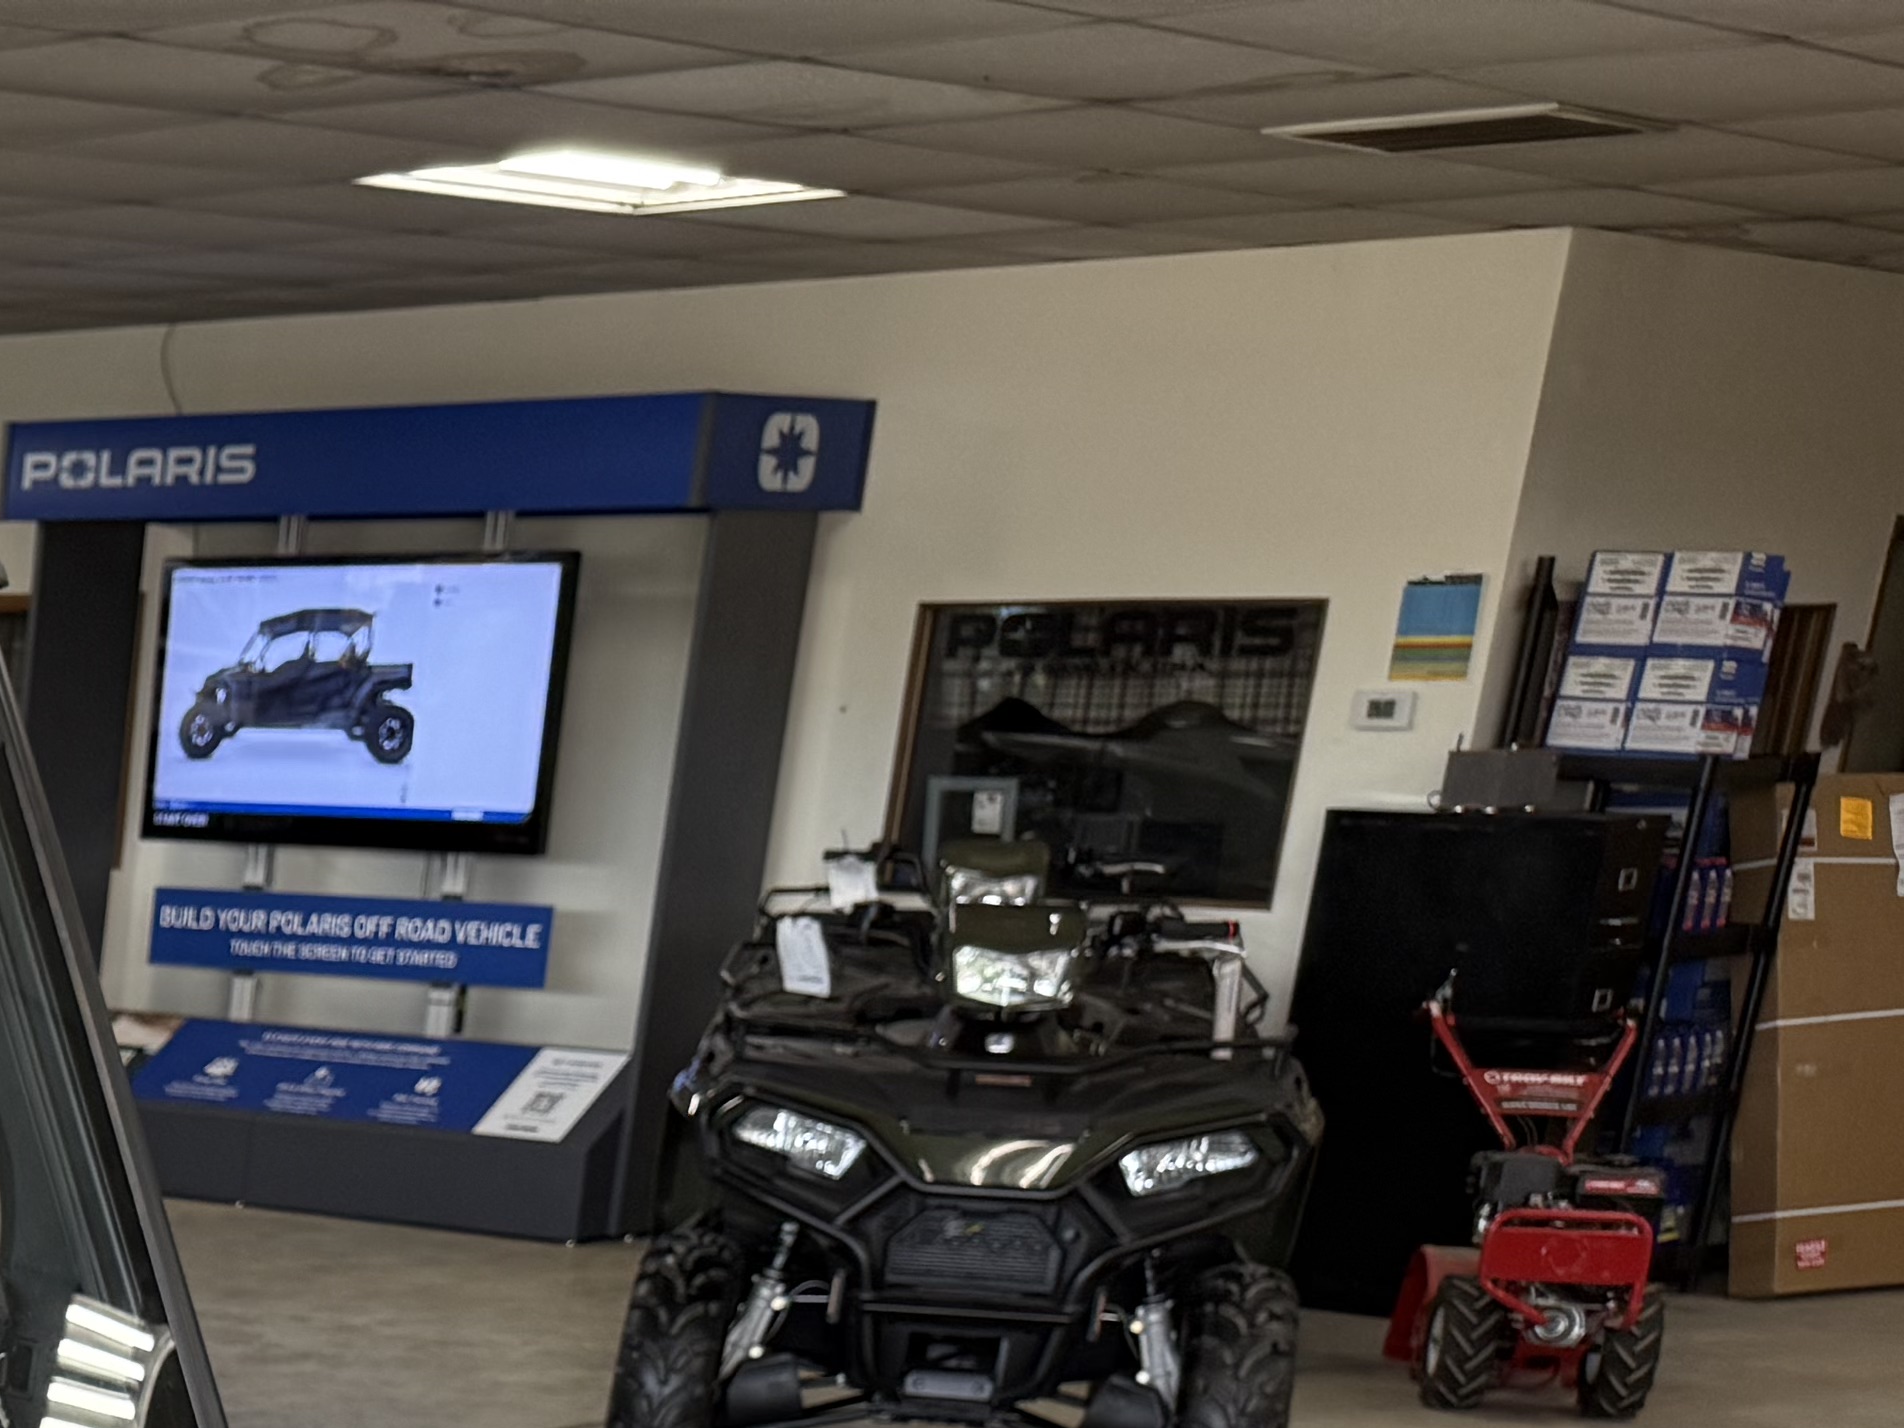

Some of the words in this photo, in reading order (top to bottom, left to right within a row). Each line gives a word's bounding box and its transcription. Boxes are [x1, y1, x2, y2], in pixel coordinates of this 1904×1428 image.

[20, 443, 257, 491] POLARIS
[946, 606, 1299, 659] POLARIS
[159, 905, 215, 931] BUILD
[216, 908, 267, 934] YOUR
[269, 910, 353, 939] POLARIS
[353, 915, 394, 941] OFF
[394, 917, 452, 945] ROAD
[454, 919, 543, 950] VEHICLE
[230, 938, 270, 957] TOUCH
[270, 940, 296, 958] THE
[298, 942, 350, 962] SCREEN
[351, 945, 365, 963] TO
[395, 948, 459, 969] STARTED
